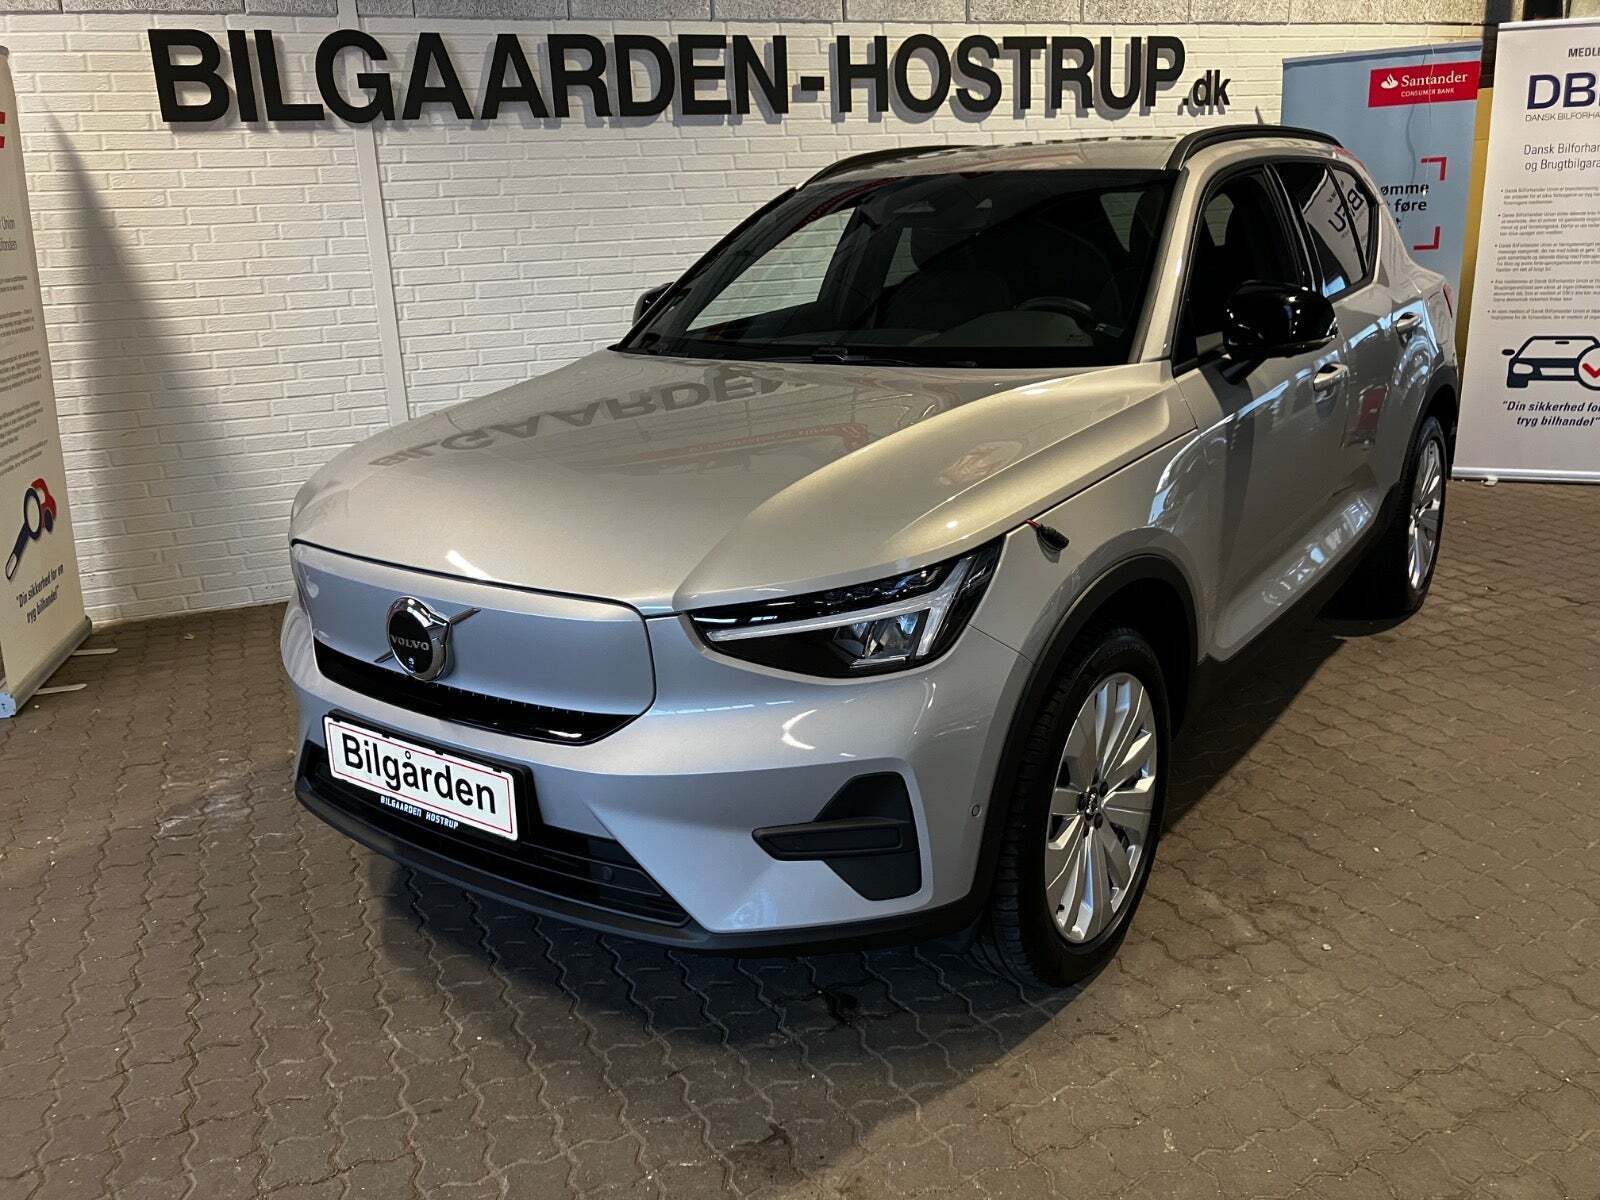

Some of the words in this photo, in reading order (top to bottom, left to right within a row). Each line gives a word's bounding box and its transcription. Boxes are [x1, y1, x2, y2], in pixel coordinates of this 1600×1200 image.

[1401, 70, 1468, 88] Santander
[1436, 87, 1455, 95] BANK
[1525, 113, 1556, 122] DANSK
[1523, 144, 1554, 156] Dansk
[1524, 162, 1538, 173] og
[1394, 198, 1428, 213] føre
[1528, 401, 1585, 412] sikkerhed
[1516, 416, 1538, 427] tryg
[389, 634, 430, 651] VOLVO
[341, 732, 497, 815] Bilgården
[379, 795, 422, 817] BILGAARDEN
[425, 810, 459, 830] HOSTRUP
